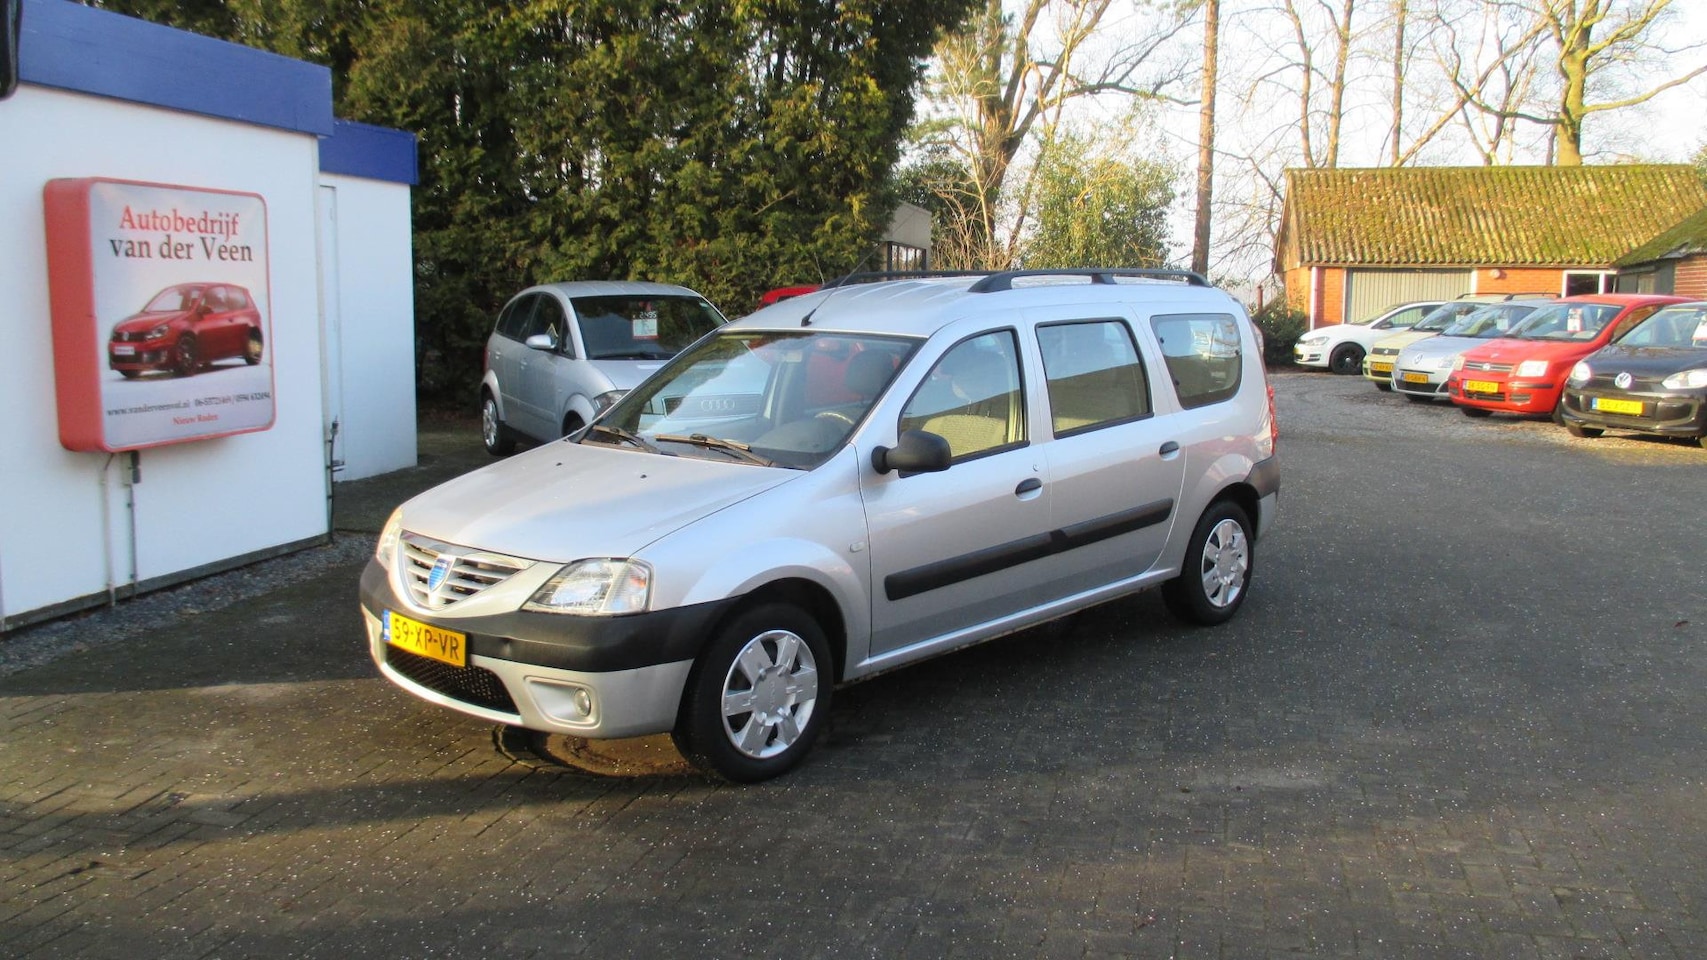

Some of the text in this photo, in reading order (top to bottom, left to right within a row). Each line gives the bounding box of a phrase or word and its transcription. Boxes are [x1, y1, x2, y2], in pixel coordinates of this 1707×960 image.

[119, 205, 240, 242] Autobedrijf
[109, 235, 253, 262] van der Veen
[394, 617, 460, 661] 59-XP-VR
